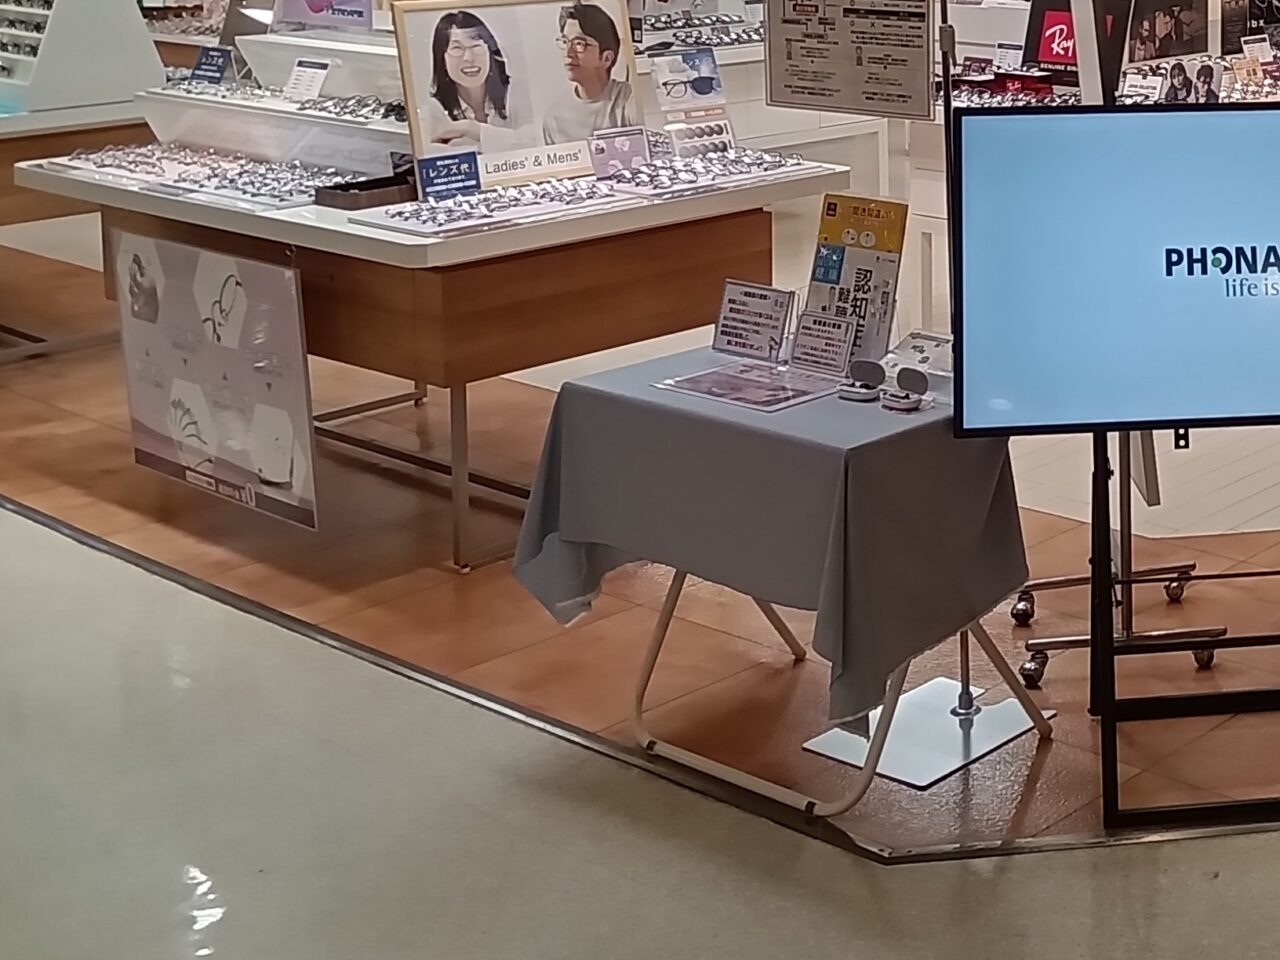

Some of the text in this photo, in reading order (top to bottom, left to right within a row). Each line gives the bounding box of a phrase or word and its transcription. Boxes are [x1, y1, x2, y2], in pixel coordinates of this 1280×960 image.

[485, 150, 582, 175] Ladies' & Mens'
[1225, 278, 1259, 297] life
[1264, 278, 1280, 296] is
